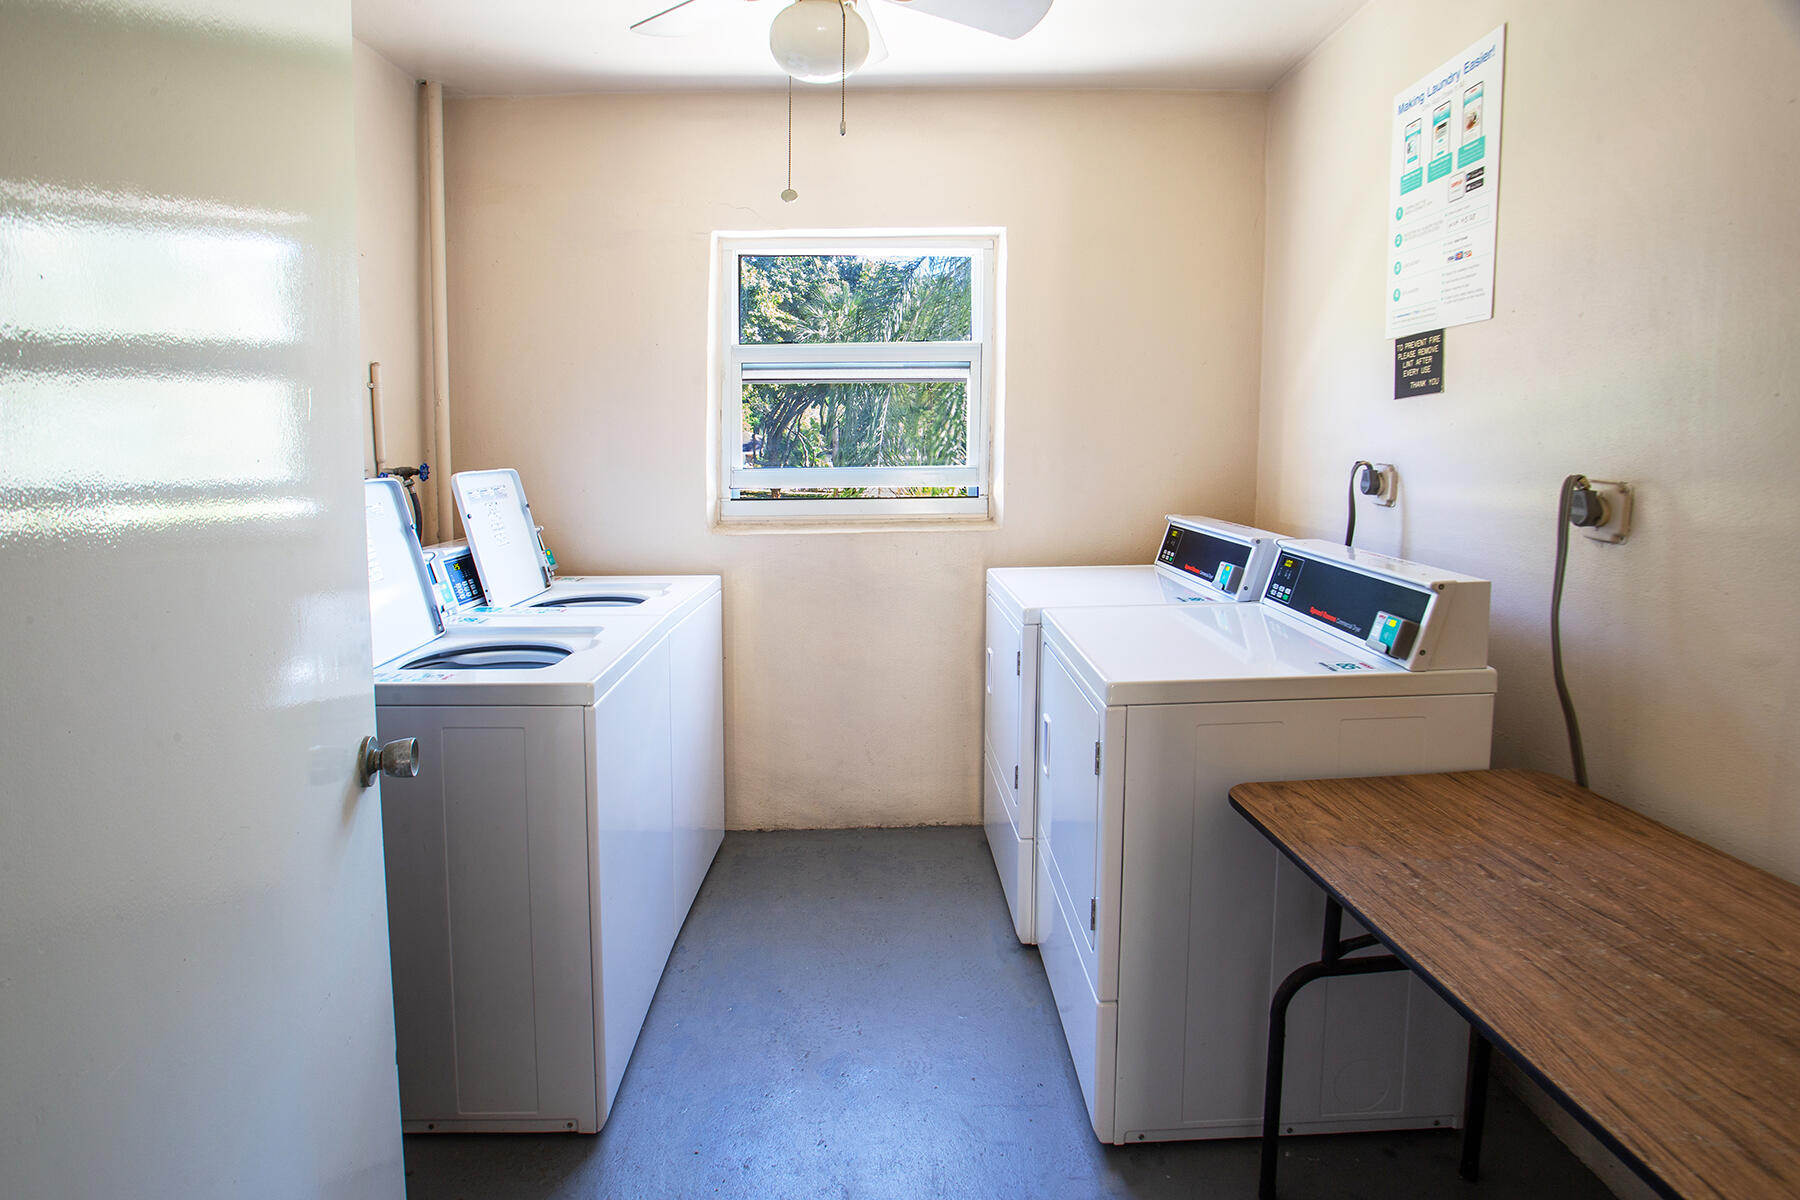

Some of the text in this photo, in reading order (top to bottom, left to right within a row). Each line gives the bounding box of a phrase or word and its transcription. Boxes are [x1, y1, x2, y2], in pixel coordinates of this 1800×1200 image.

[1397, 92, 1425, 115] Making
[1427, 69, 1461, 97] Laundry
[1404, 337, 1427, 349] PREVENT
[1429, 335, 1441, 343] FIRE
[1397, 345, 1439, 360] PLEASE REMOVE
[1402, 356, 1432, 368] LINT AFTER
[1402, 365, 1432, 377] EVERY USE
[1410, 377, 1440, 388] THANK YOU
